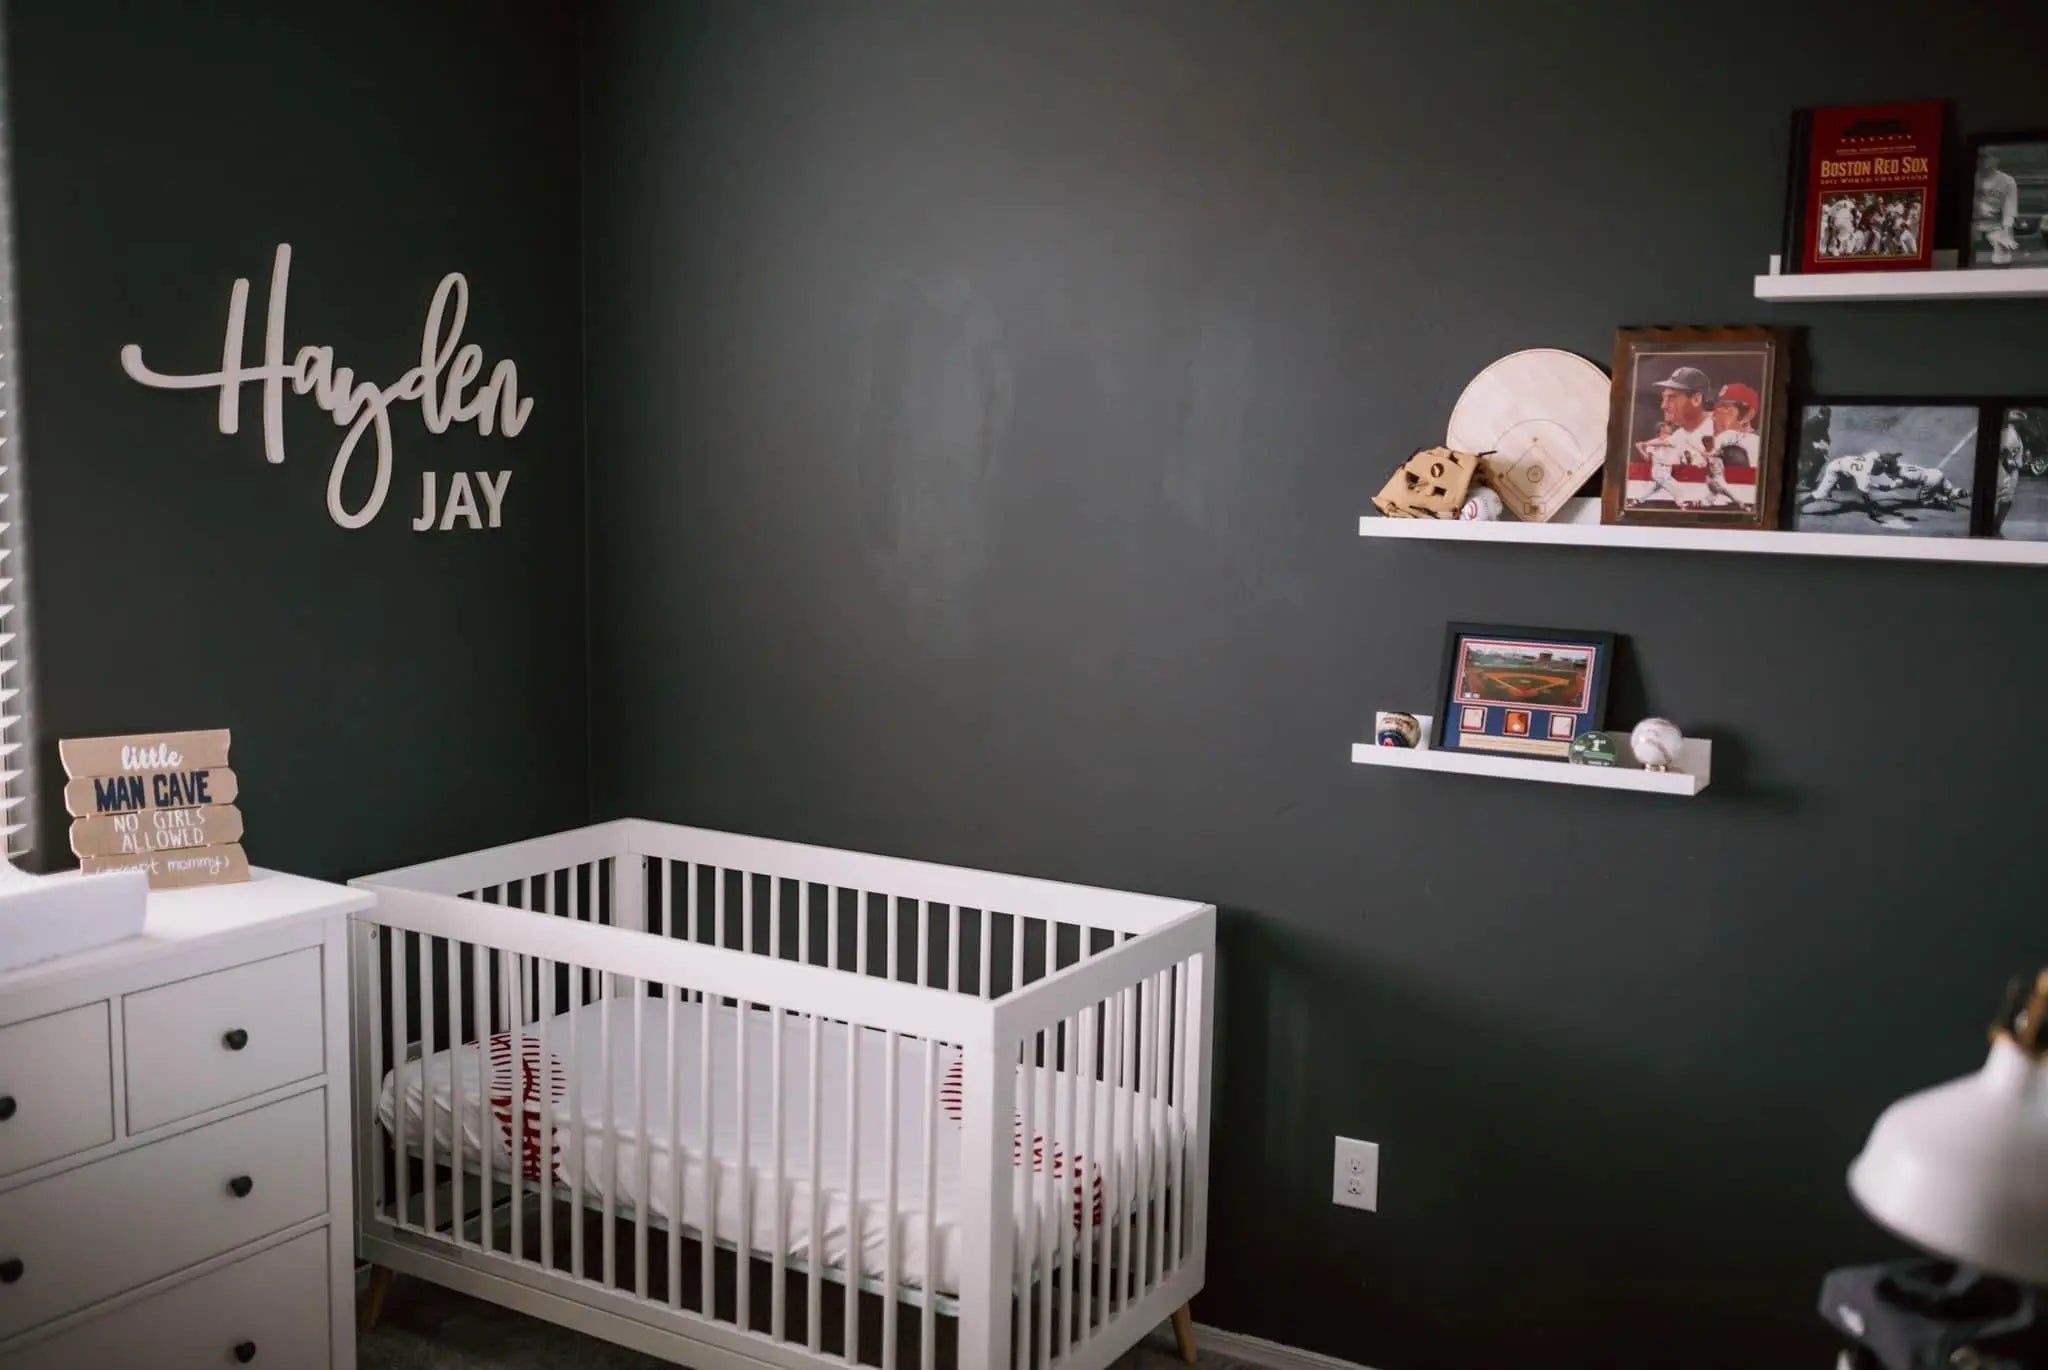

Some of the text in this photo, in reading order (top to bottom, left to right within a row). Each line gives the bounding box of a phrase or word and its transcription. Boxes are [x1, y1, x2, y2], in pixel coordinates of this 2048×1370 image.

[1820, 156, 1929, 178] BOSTON RED SOX
[121, 243, 534, 528] Hayden
[412, 470, 513, 531] JAY
[121, 742, 184, 770] little
[94, 770, 212, 812] MAN CAVE
[114, 807, 206, 833] NO GIRLS
[122, 827, 204, 854] ALLOWED
